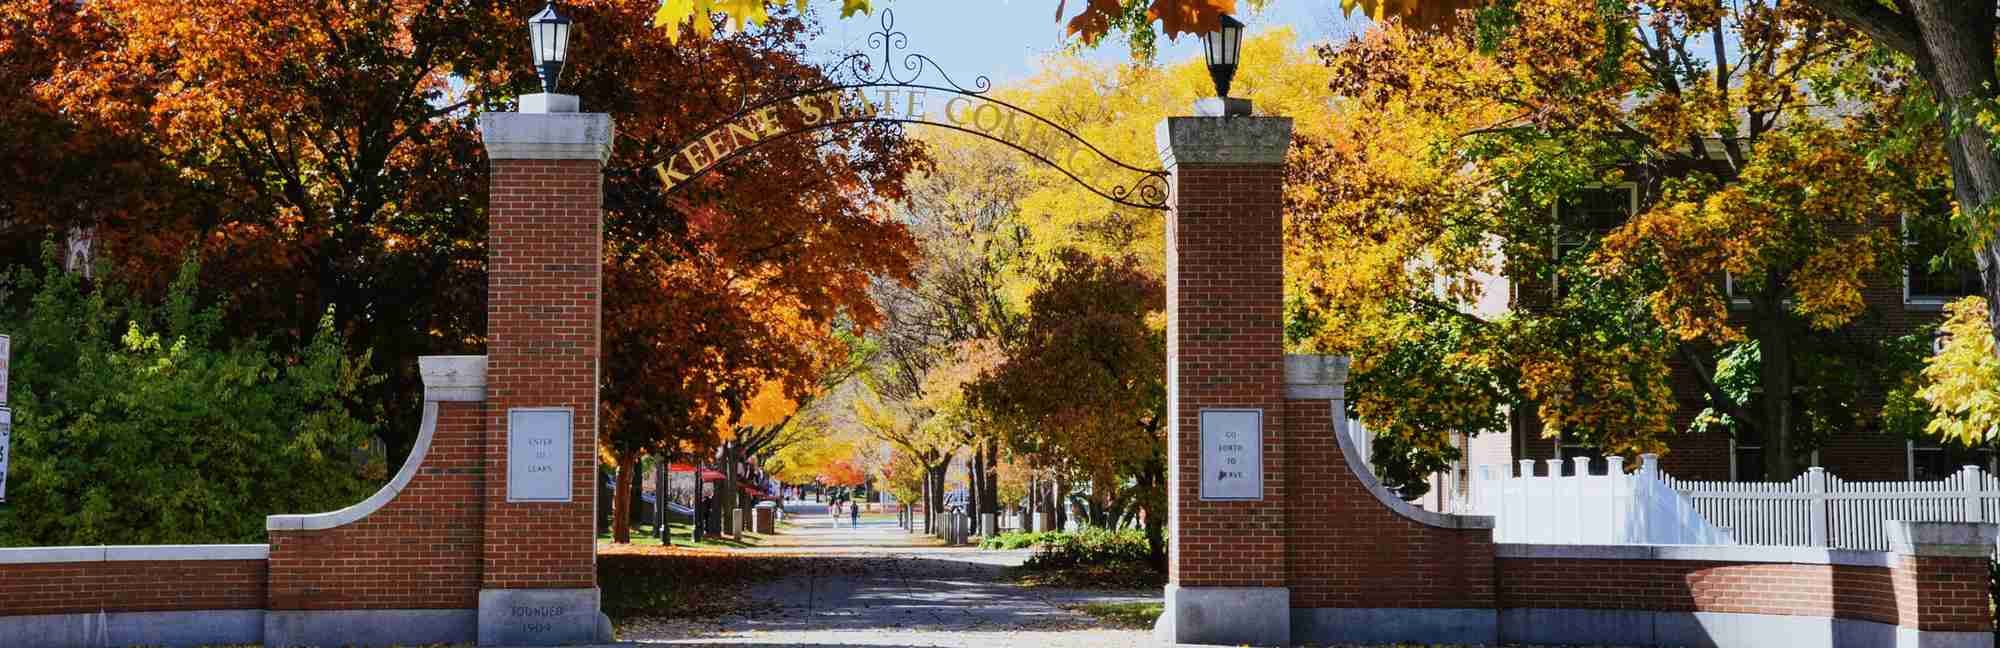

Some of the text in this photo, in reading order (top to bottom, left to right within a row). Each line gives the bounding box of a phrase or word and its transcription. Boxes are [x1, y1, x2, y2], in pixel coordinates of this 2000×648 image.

[656, 106, 783, 191] KEENE
[800, 86, 926, 124] STATE
[521, 623, 552, 633] 1909
